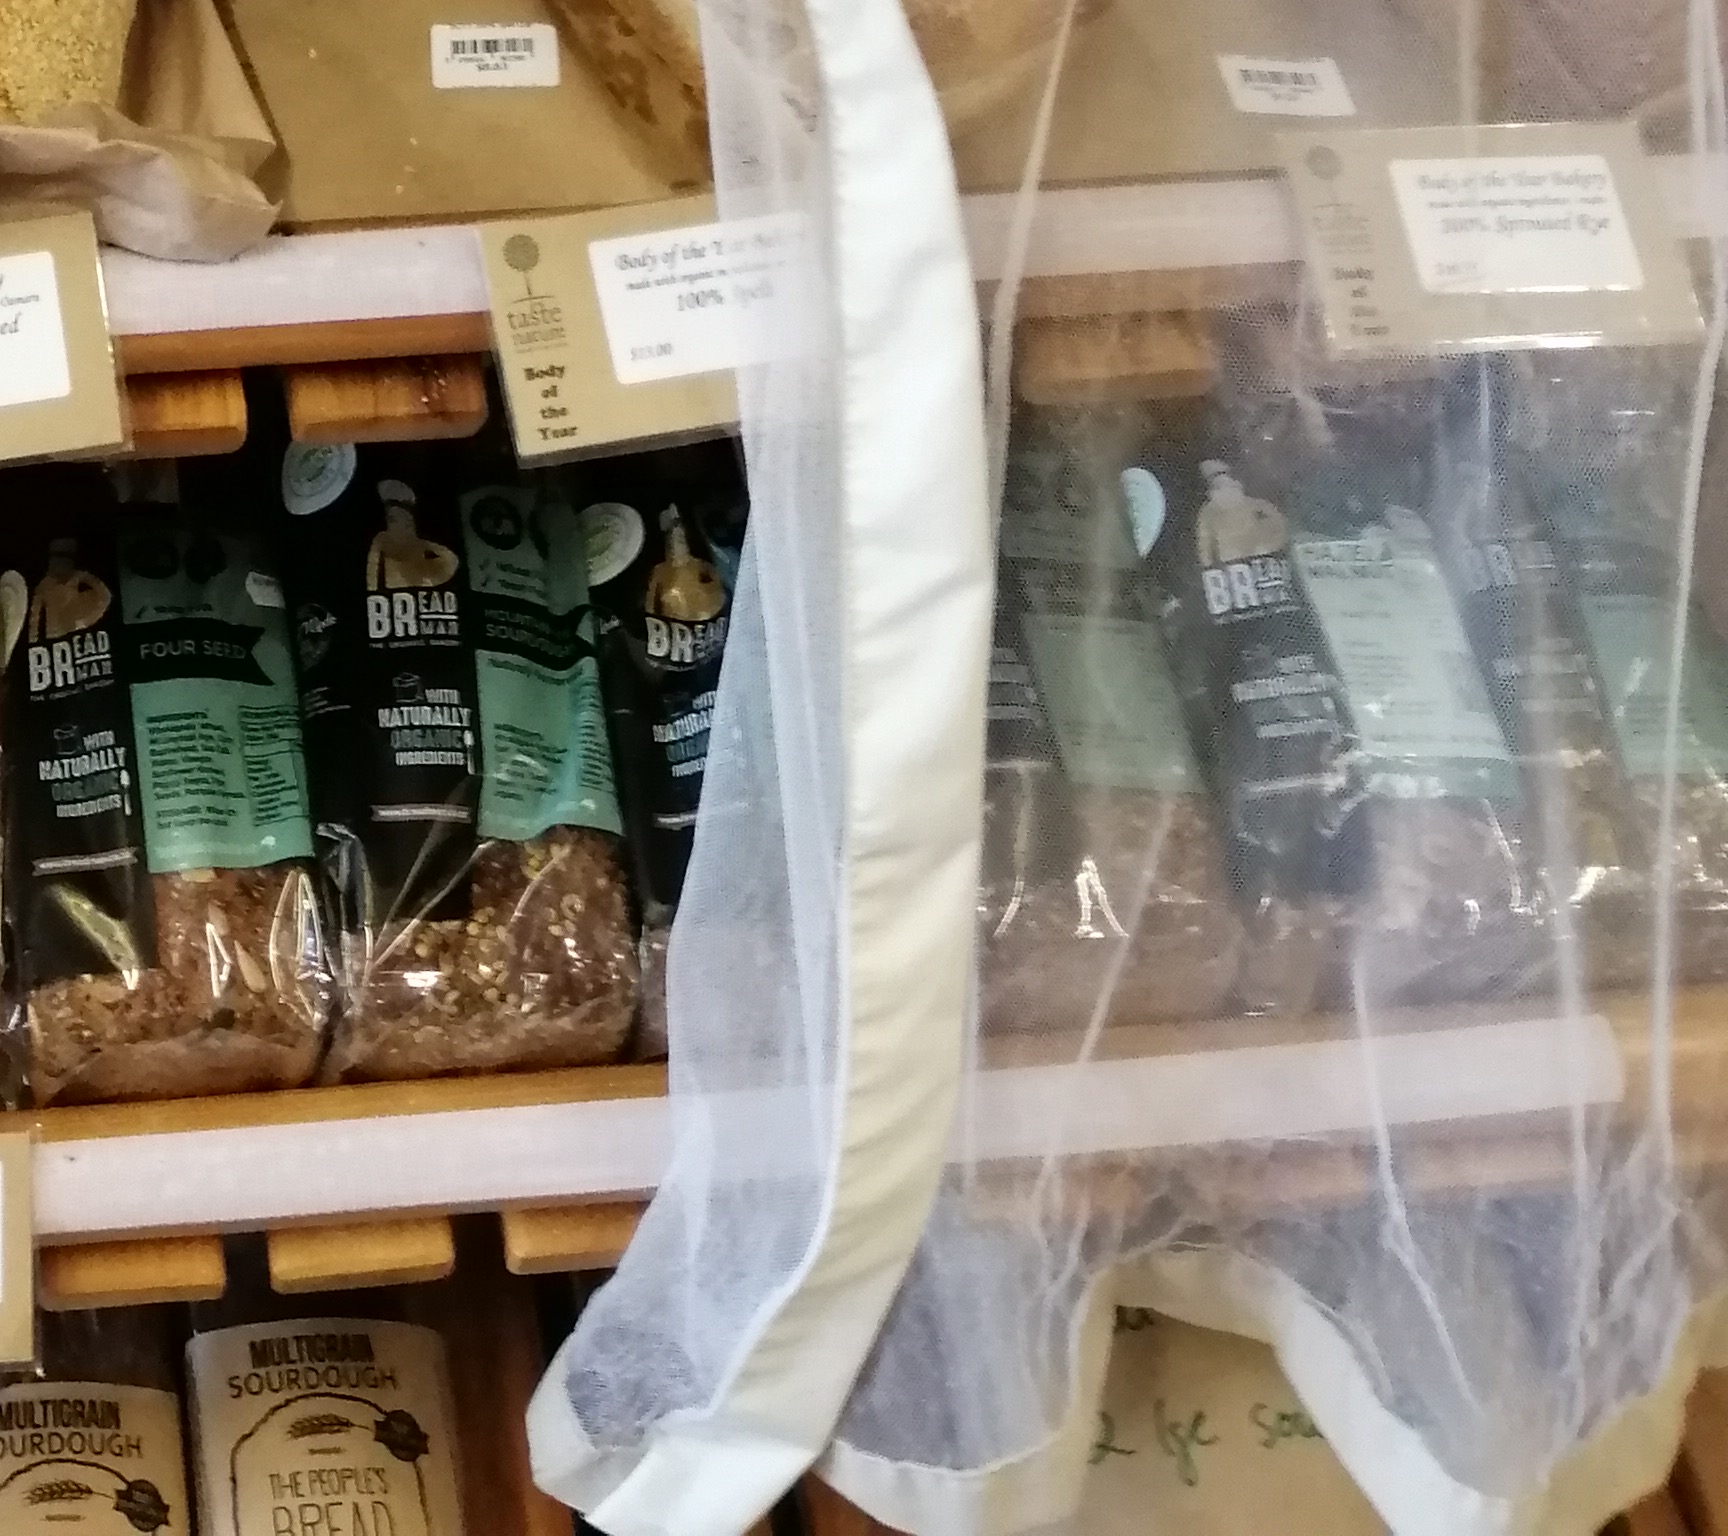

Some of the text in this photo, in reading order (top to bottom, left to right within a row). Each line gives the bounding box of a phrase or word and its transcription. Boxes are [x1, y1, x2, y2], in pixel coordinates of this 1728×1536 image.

[615, 249, 657, 271] Body
[682, 241, 706, 260] the
[524, 365, 565, 381] Body
[541, 385, 557, 399] of
[540, 407, 567, 419] the
[537, 427, 578, 441] Year
[367, 591, 458, 638] BREAD
[28, 631, 111, 691] BREAD
[140, 640, 247, 660] FOUR SEED
[378, 706, 471, 728] NATURALLY
[39, 747, 126, 780] NATURALLY
[249, 1334, 375, 1369] MULTIGRAIN
[228, 1365, 399, 1398] SOURDOUGH
[269, 1467, 389, 1499] THE PEOPLE'S
[272, 1501, 396, 1536] BREAD
